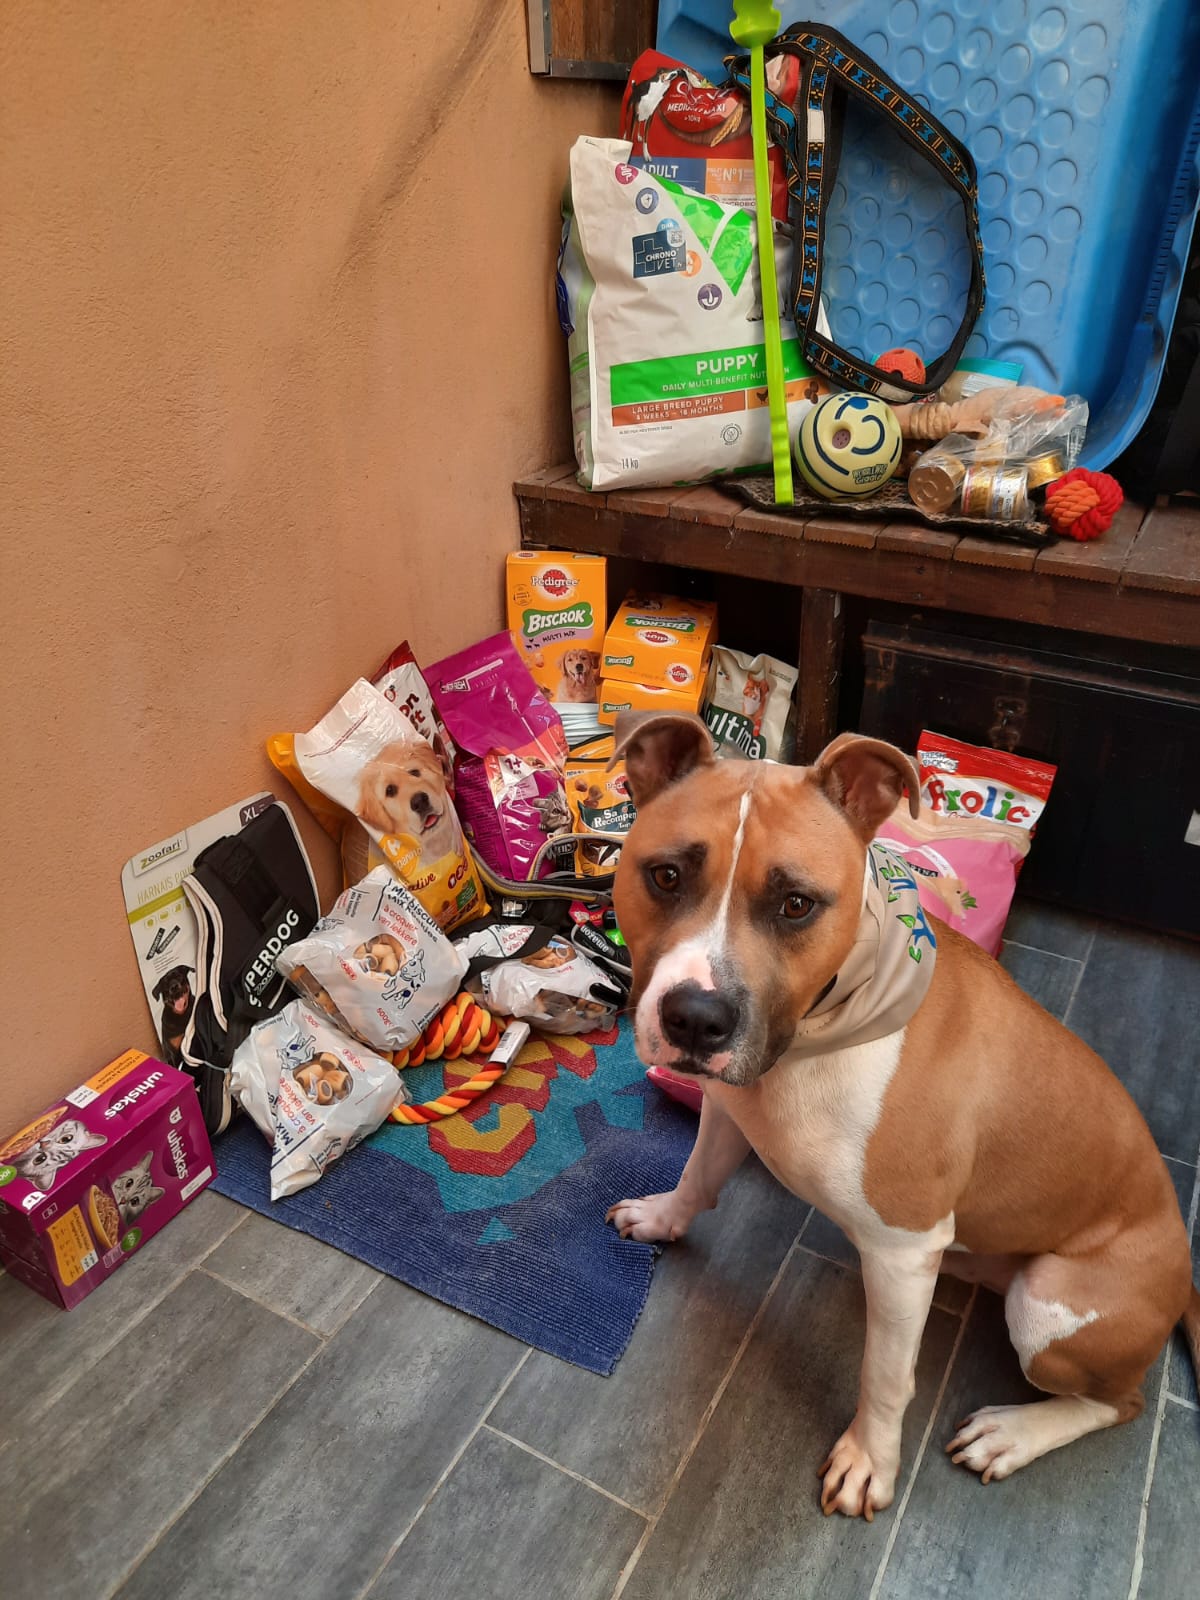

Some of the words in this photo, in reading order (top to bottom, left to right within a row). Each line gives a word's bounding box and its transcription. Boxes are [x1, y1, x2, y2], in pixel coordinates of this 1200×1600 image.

[642, 164, 679, 179] ADULT
[645, 250, 677, 262] CHRONO
[656, 257, 677, 270] VET
[696, 353, 759, 376] PUPPY
[661, 383, 687, 392] DAILY
[688, 374, 747, 389] MULTI-BENEFIT
[632, 404, 660, 414] LARGE
[663, 400, 692, 411] BREED
[695, 397, 723, 407] PUPPY
[643, 410, 670, 420] WEEKS
[690, 403, 724, 415] MONTHS
[622, 458, 630, 470] 14
[630, 458, 639, 470] kg
[531, 575, 580, 588] Pedigree
[542, 633, 562, 643] MULTI
[563, 630, 576, 638] MIX
[706, 711, 761, 759] ultima
[927, 780, 1030, 823] Frolic
[243, 806, 259, 822] XL
[603, 809, 618, 818] Sa
[137, 879, 174, 905] HARNAIS
[391, 885, 411, 902] Mix
[390, 920, 418, 946] lekkere
[580, 924, 609, 953] amazon
[104, 1071, 164, 1118] whiskas
[279, 1077, 304, 1117] lekkere
[278, 1095, 303, 1125] croque
[302, 1108, 316, 1125] van
[276, 1122, 294, 1146] Mix
[167, 1129, 189, 1180] whiskas
